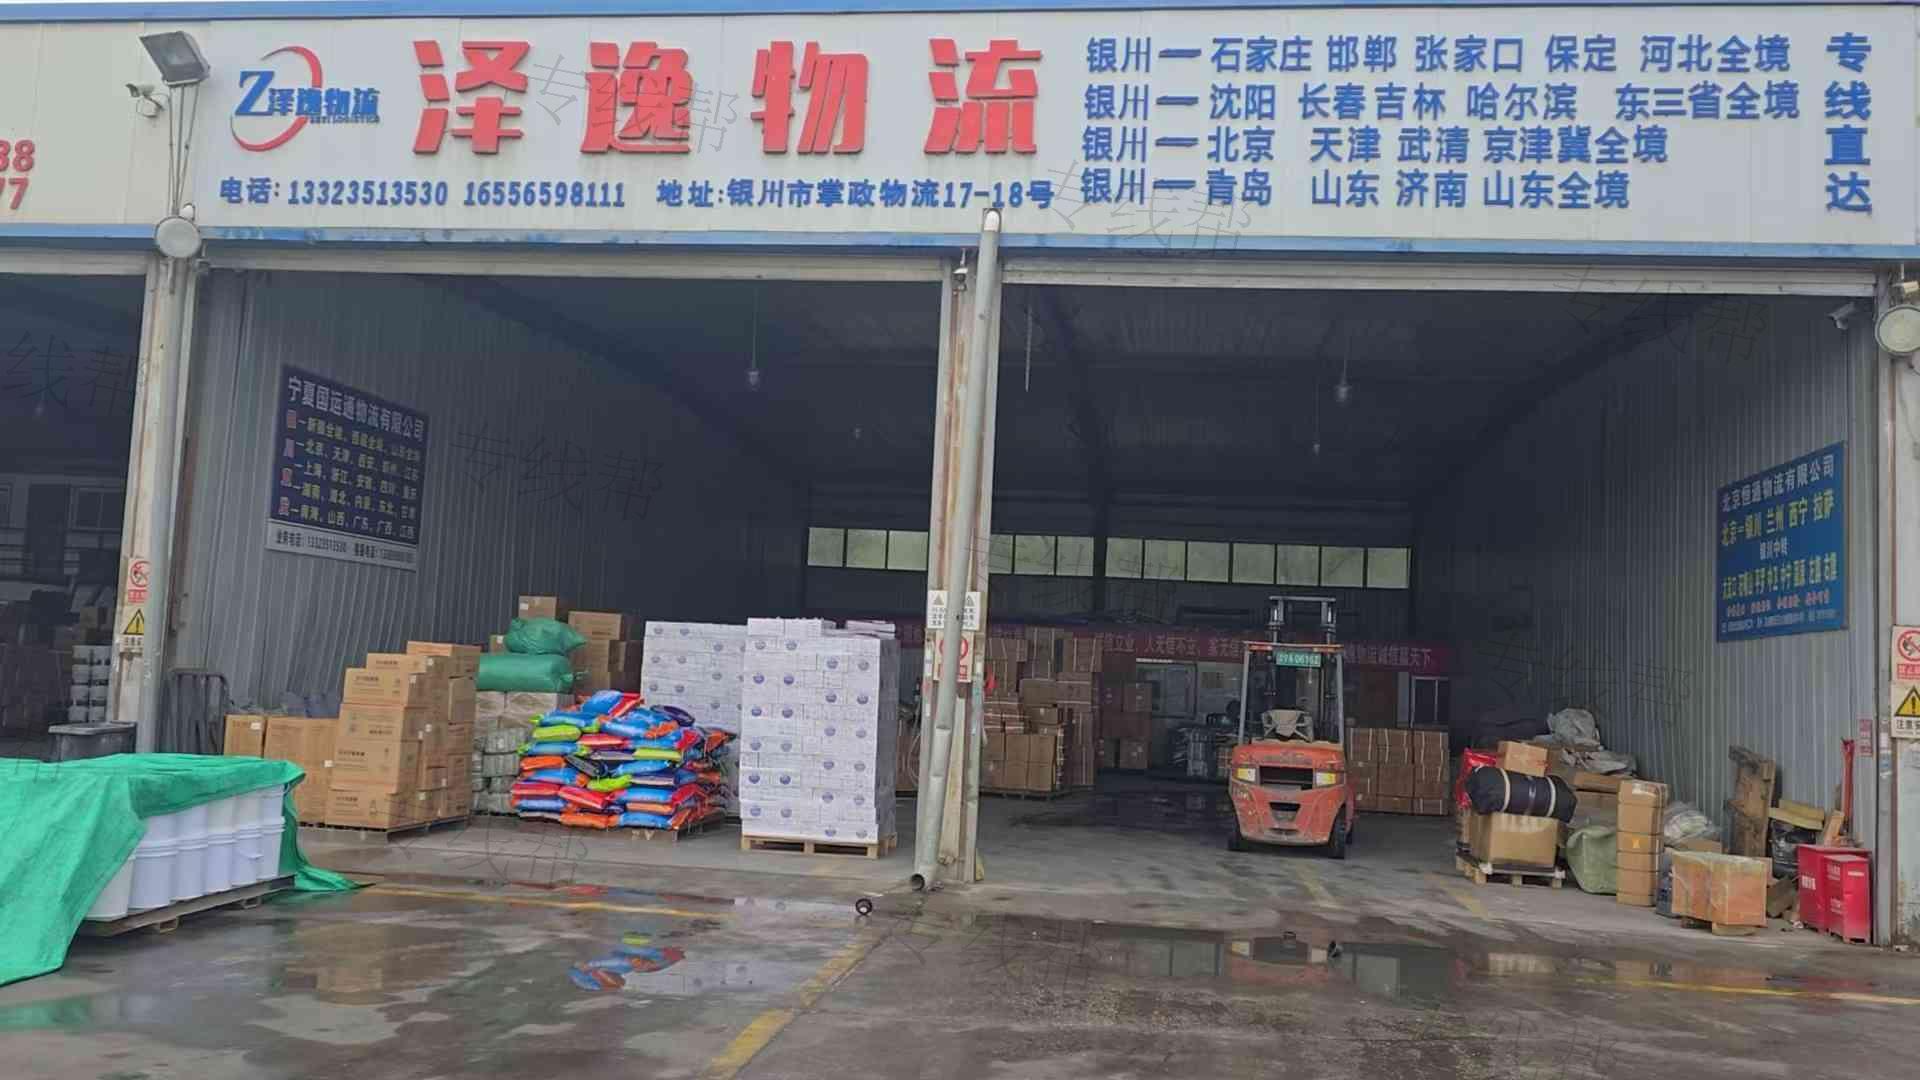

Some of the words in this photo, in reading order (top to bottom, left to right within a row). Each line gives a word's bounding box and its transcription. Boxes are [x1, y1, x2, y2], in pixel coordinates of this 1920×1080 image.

[1327, 34, 1397, 73] 邯郸
[1415, 34, 1524, 73] 张家口
[1545, 34, 1617, 73] 保定
[1640, 34, 1791, 73] 河北全境
[412, 38, 1043, 155] 泽逸物流
[1466, 82, 1578, 121] 哈尔滨
[1615, 80, 1801, 121] 东三省全境
[1310, 126, 1382, 163] 天津
[1397, 125, 1470, 163] 武清
[1483, 125, 1668, 164] 京津冀全境
[1824, 32, 1872, 216] 专线直达
[463, 181, 626, 208] 16556598111
[1311, 168, 1381, 207] 山东
[1396, 168, 1469, 208] 济南
[1483, 170, 1630, 209] 山东全境
